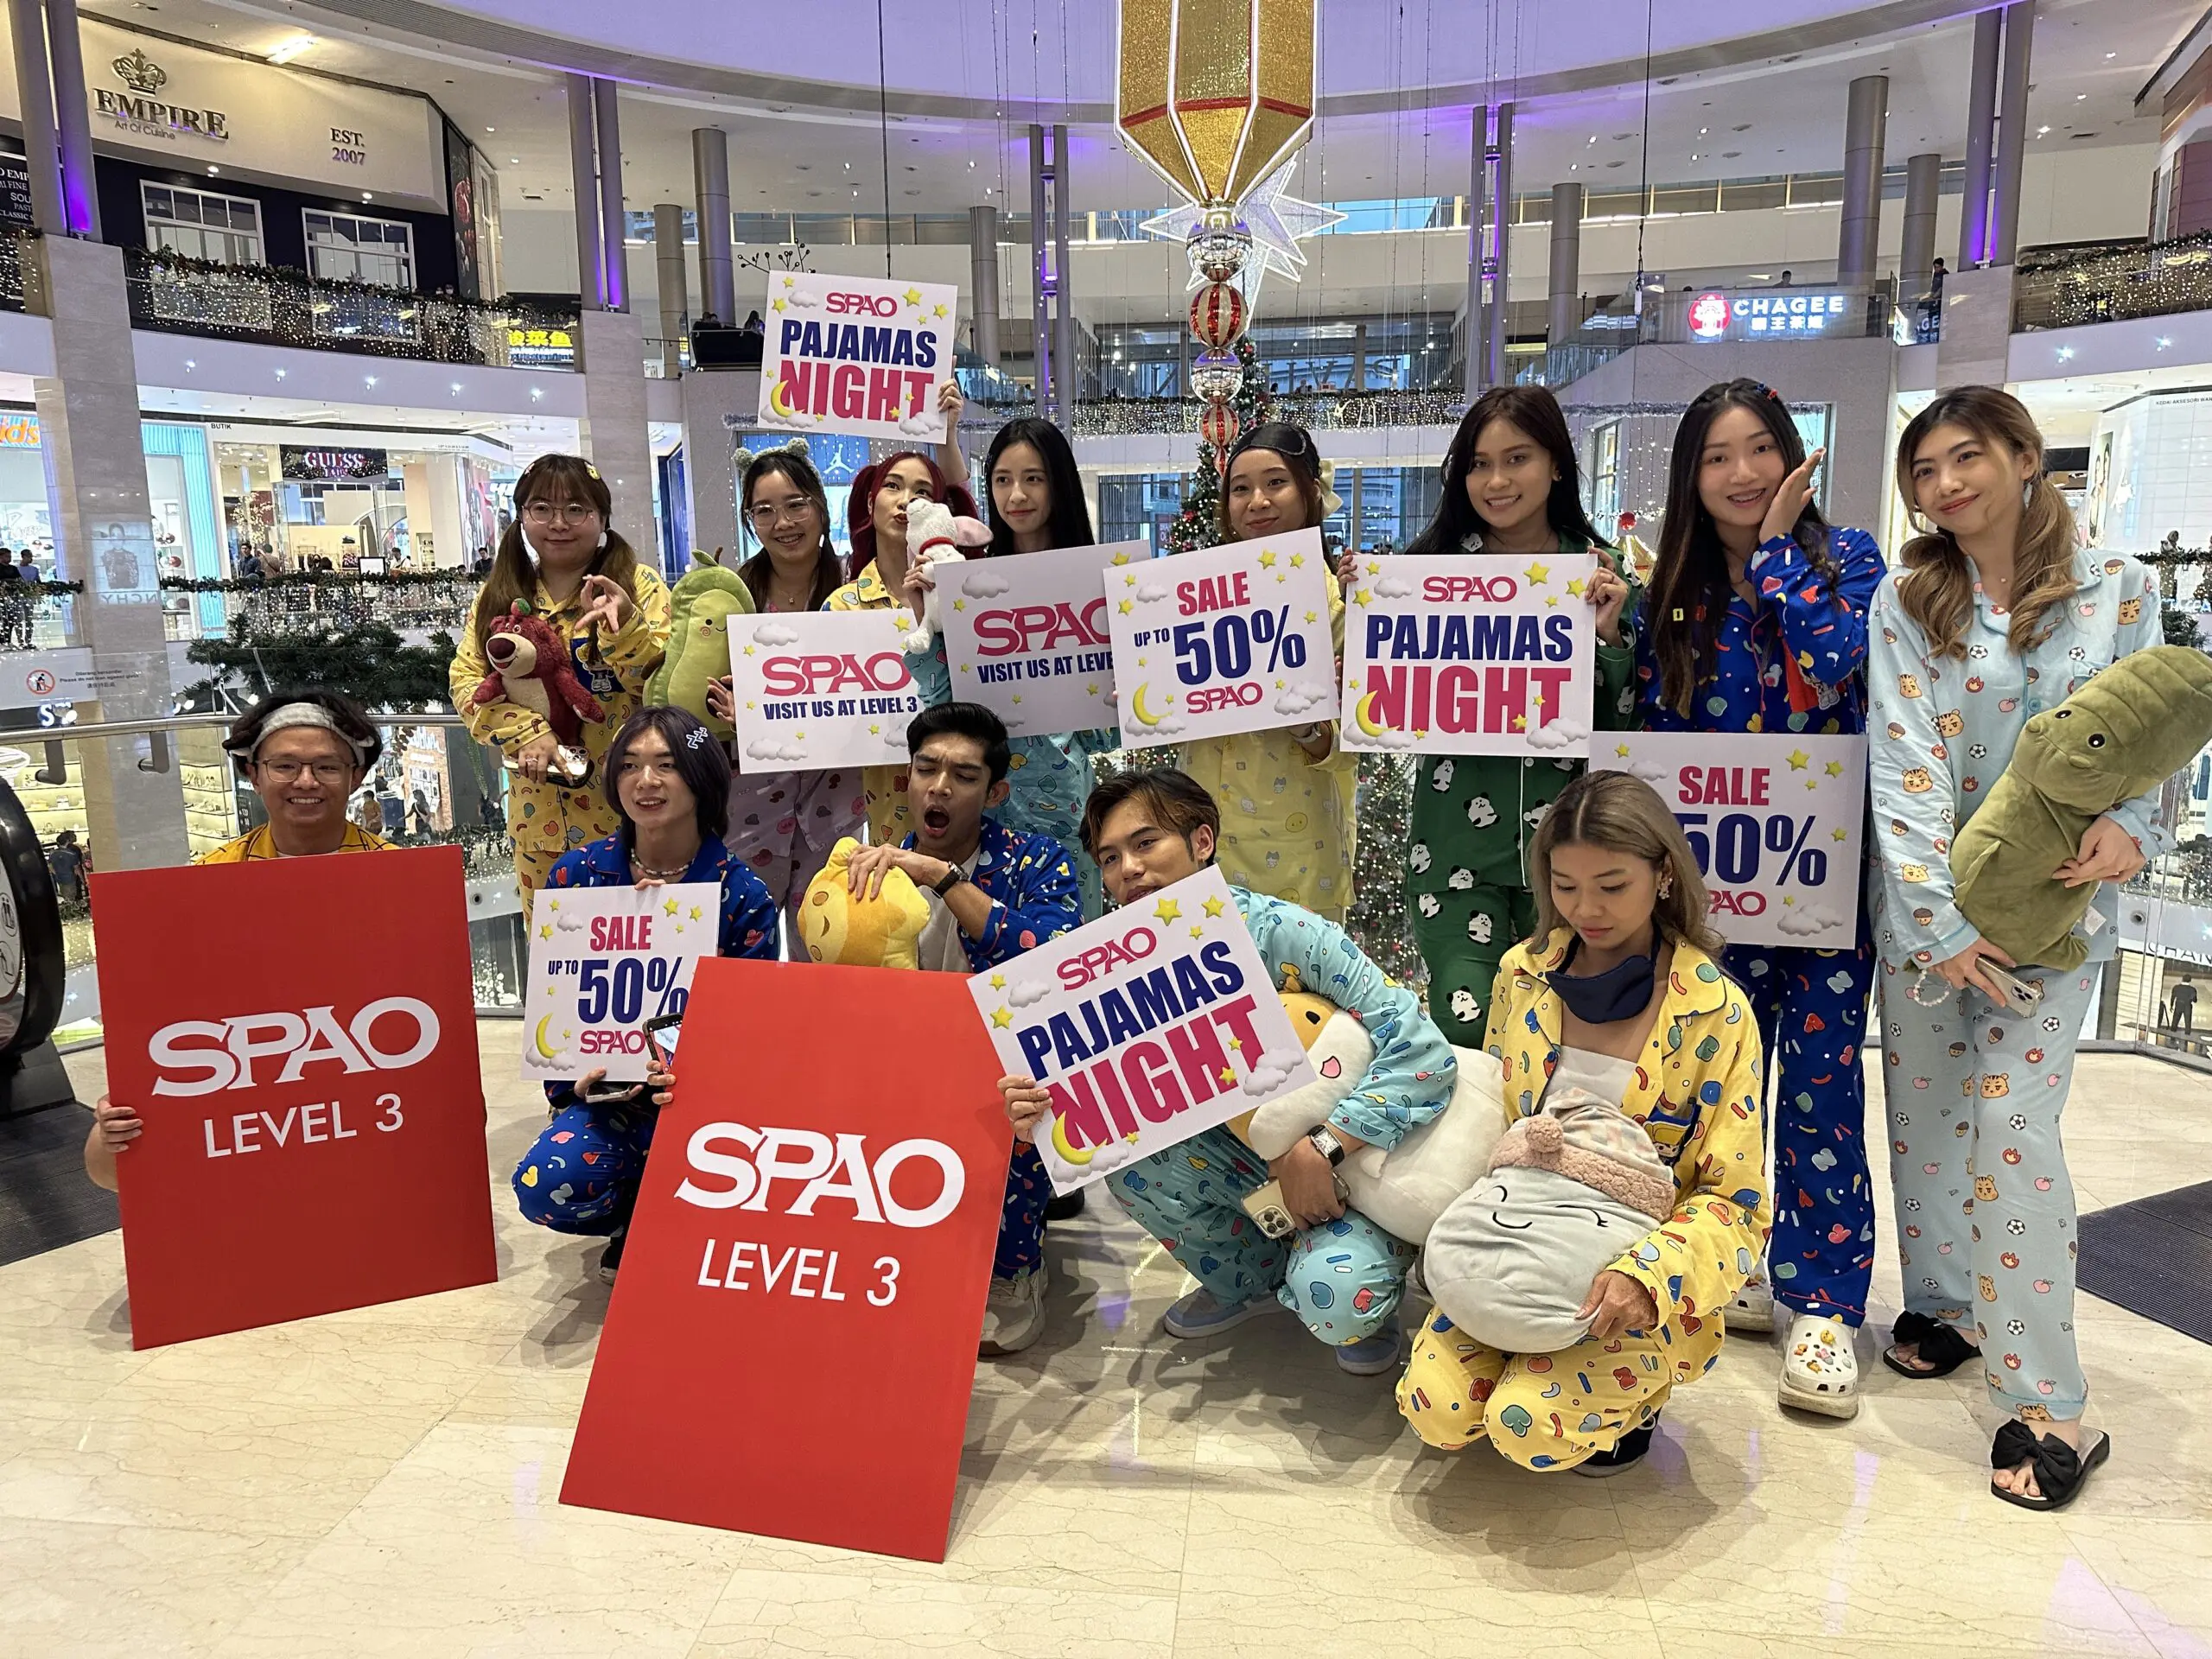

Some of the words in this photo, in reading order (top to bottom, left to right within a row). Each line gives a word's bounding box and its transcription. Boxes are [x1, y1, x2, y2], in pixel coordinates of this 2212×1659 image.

[92, 88, 229, 140] EMPIRE
[114, 119, 129, 130] Art
[130, 122, 142, 133] Of
[144, 126, 175, 140] Cuisine
[330, 127, 365, 147] EST.
[332, 147, 365, 165] 2007
[826, 292, 898, 318] SPAO
[1733, 296, 1844, 316] CHAGEE
[780, 319, 937, 368] PAJAMAS
[779, 359, 935, 423] NIGHT
[304, 452, 368, 468] GUESS
[1176, 571, 1250, 617] SALE
[1422, 575, 1517, 602] SPAO
[1134, 632, 1151, 647] UP
[1154, 627, 1170, 644] TO
[1173, 604, 1306, 685] 50%
[1365, 614, 1573, 662] PAJAMAS
[762, 652, 912, 696] SPAO
[977, 661, 1023, 683] VISIT
[1027, 658, 1050, 678] US
[1054, 656, 1073, 675] AT
[763, 702, 808, 721] VISIT
[811, 700, 835, 718] US
[837, 699, 856, 716] AT
[860, 697, 904, 715] LEVEL
[906, 696, 918, 712] 3
[1185, 682, 1263, 714] SPAO
[1366, 665, 1571, 734] NIGHT
[1678, 766, 1770, 806] SALE
[1672, 812, 1827, 887] 50%
[1707, 890, 1767, 917] PAO
[589, 915, 653, 952] SALE
[1056, 927, 1157, 992] SPAO
[548, 960, 562, 976] UP
[564, 959, 579, 975] TO
[577, 956, 690, 1024] 50%
[1015, 940, 1245, 1082] PAJAMAS
[148, 996, 441, 1097] SPAO
[579, 1030, 646, 1054] SPAO
[1045, 994, 1265, 1152] NIGHT
[204, 1100, 358, 1159] LEVEL
[375, 1093, 404, 1132] 3
[673, 1122, 966, 1228] SPAO
[697, 1238, 847, 1301] LEVEL
[866, 1255, 900, 1306] 3
